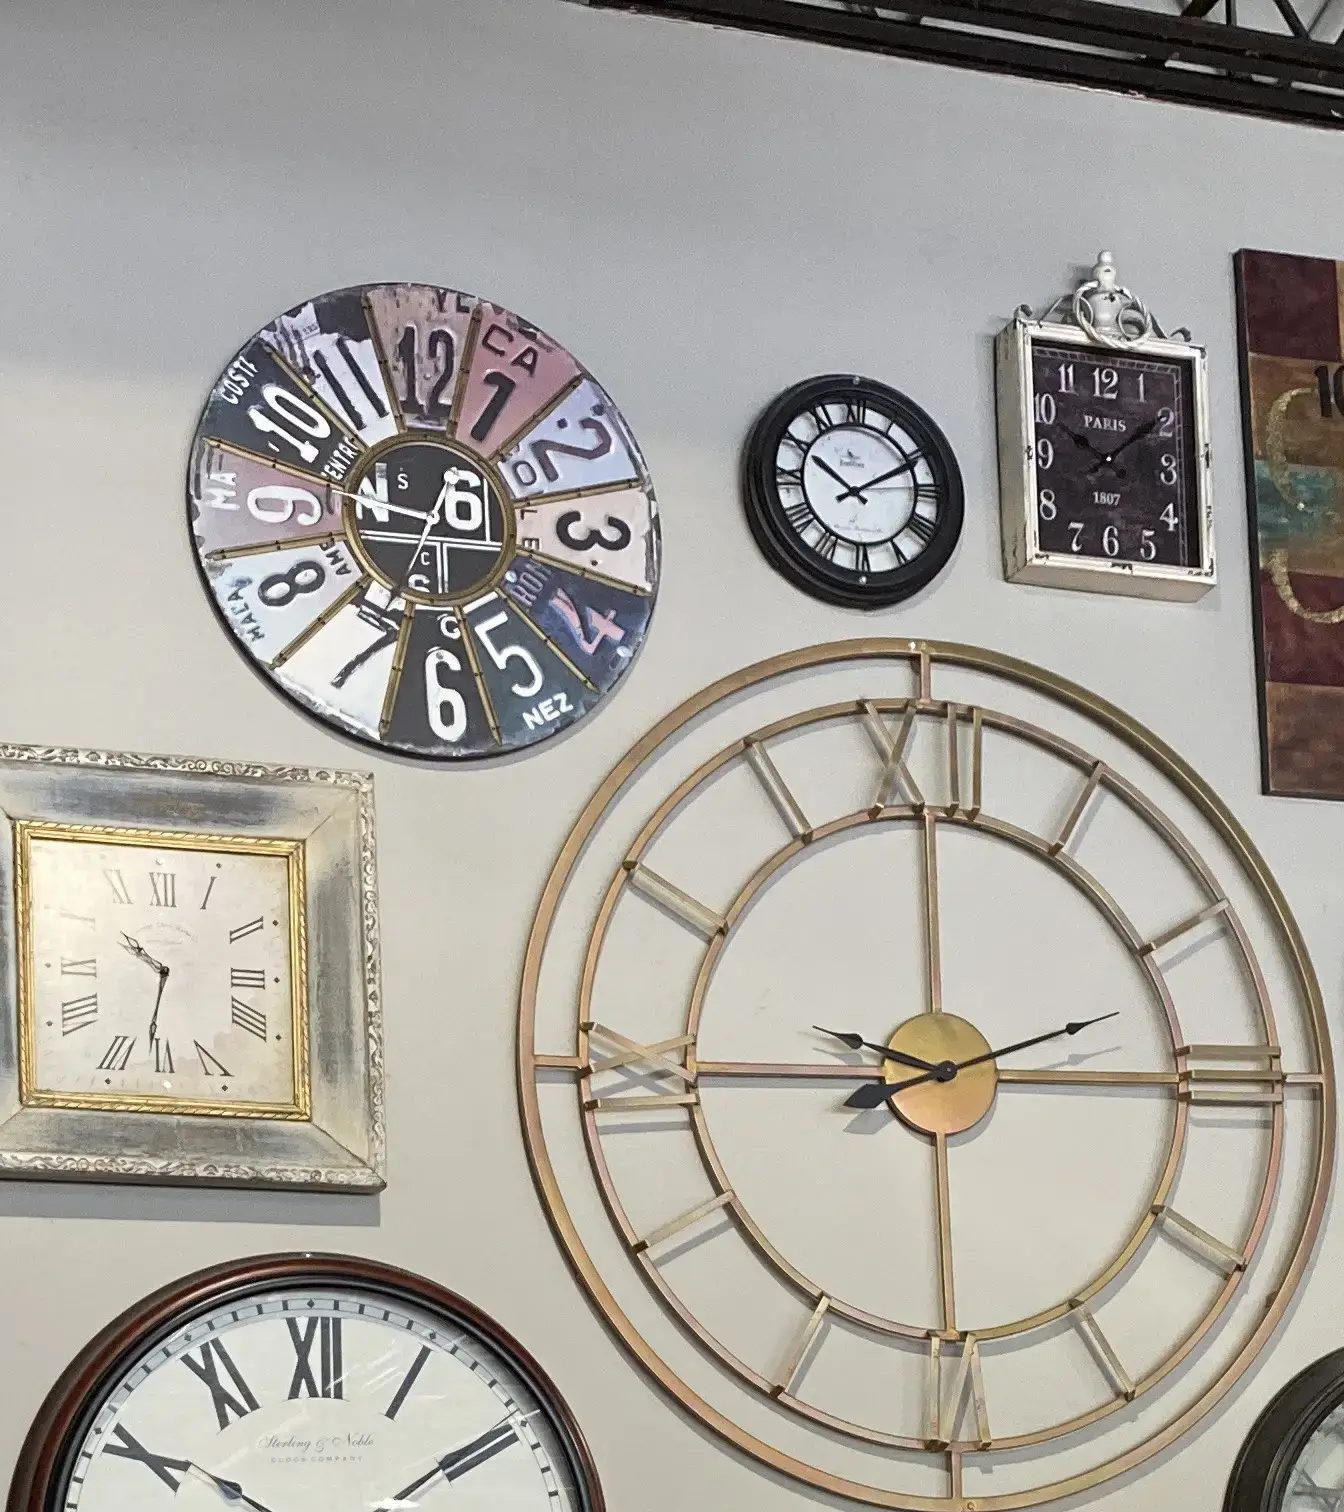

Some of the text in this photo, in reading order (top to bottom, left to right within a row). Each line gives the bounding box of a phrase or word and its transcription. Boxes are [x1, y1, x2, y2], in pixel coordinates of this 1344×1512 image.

[482, 323, 538, 377] CA
[399, 326, 454, 415] 12
[1058, 364, 1078, 396] 11
[1092, 368, 1119, 400] 12
[1137, 373, 1145, 402] 1
[248, 382, 332, 464] 10
[471, 370, 517, 442] 1
[1035, 393, 1055, 425] 10
[1157, 407, 1175, 438] 2
[1084, 415, 1127, 432] PARIS
[529, 417, 612, 482] 2
[1037, 438, 1054, 469] 9
[397, 472, 409, 490] S
[1160, 453, 1177, 485] 3
[247, 484, 322, 526] 9
[444, 467, 483, 531] 6
[1040, 488, 1057, 520] 8
[1093, 491, 1121, 505] 1807
[556, 510, 631, 551] 3
[1159, 502, 1179, 532] 4
[1068, 522, 1085, 552] 7
[1103, 526, 1120, 556] 6
[1140, 530, 1156, 561] 5
[420, 551, 431, 566] C
[257, 560, 325, 607] 8
[548, 587, 625, 654] 4
[474, 611, 544, 698] 5
[425, 646, 467, 742] 6
[522, 692, 574, 731] NEZ
[150, 872, 176, 907] XII
[200, 876, 217, 910] I
[230, 916, 263, 944] II
[230, 968, 265, 990] III
[285, 1317, 349, 1402] XII
[179, 1337, 262, 1435] XI
[380, 1344, 434, 1421] I
[102, 1422, 192, 1493] X
